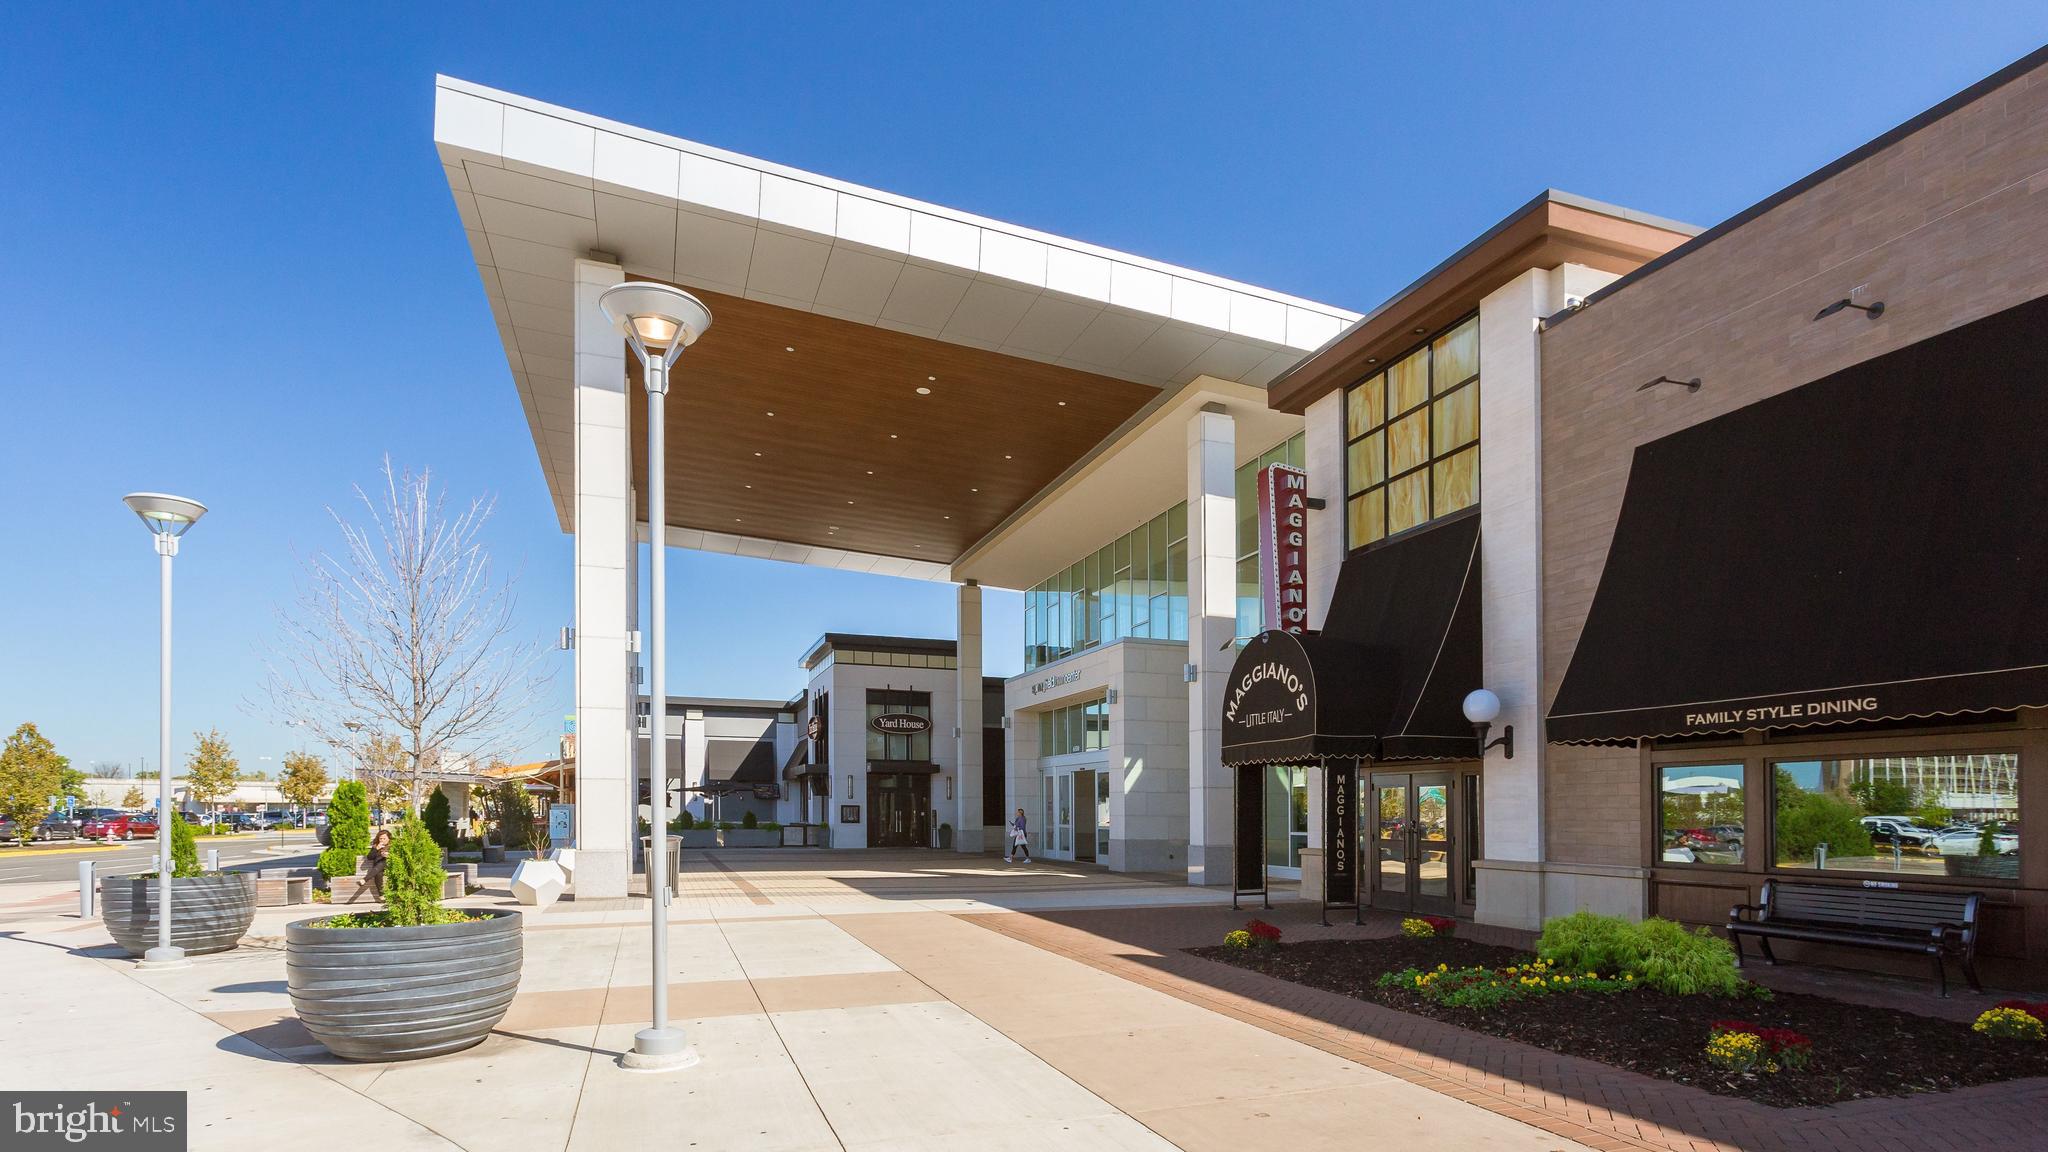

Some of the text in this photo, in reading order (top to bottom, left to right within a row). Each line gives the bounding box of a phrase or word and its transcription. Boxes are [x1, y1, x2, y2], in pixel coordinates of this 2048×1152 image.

[1226, 662, 1308, 722] MAGGIANO'S
[879, 717, 925, 729] Yard House
[1245, 707, 1285, 728] LITTLE ITALY
[1686, 697, 1878, 726] FAMILY STYLE DINING
